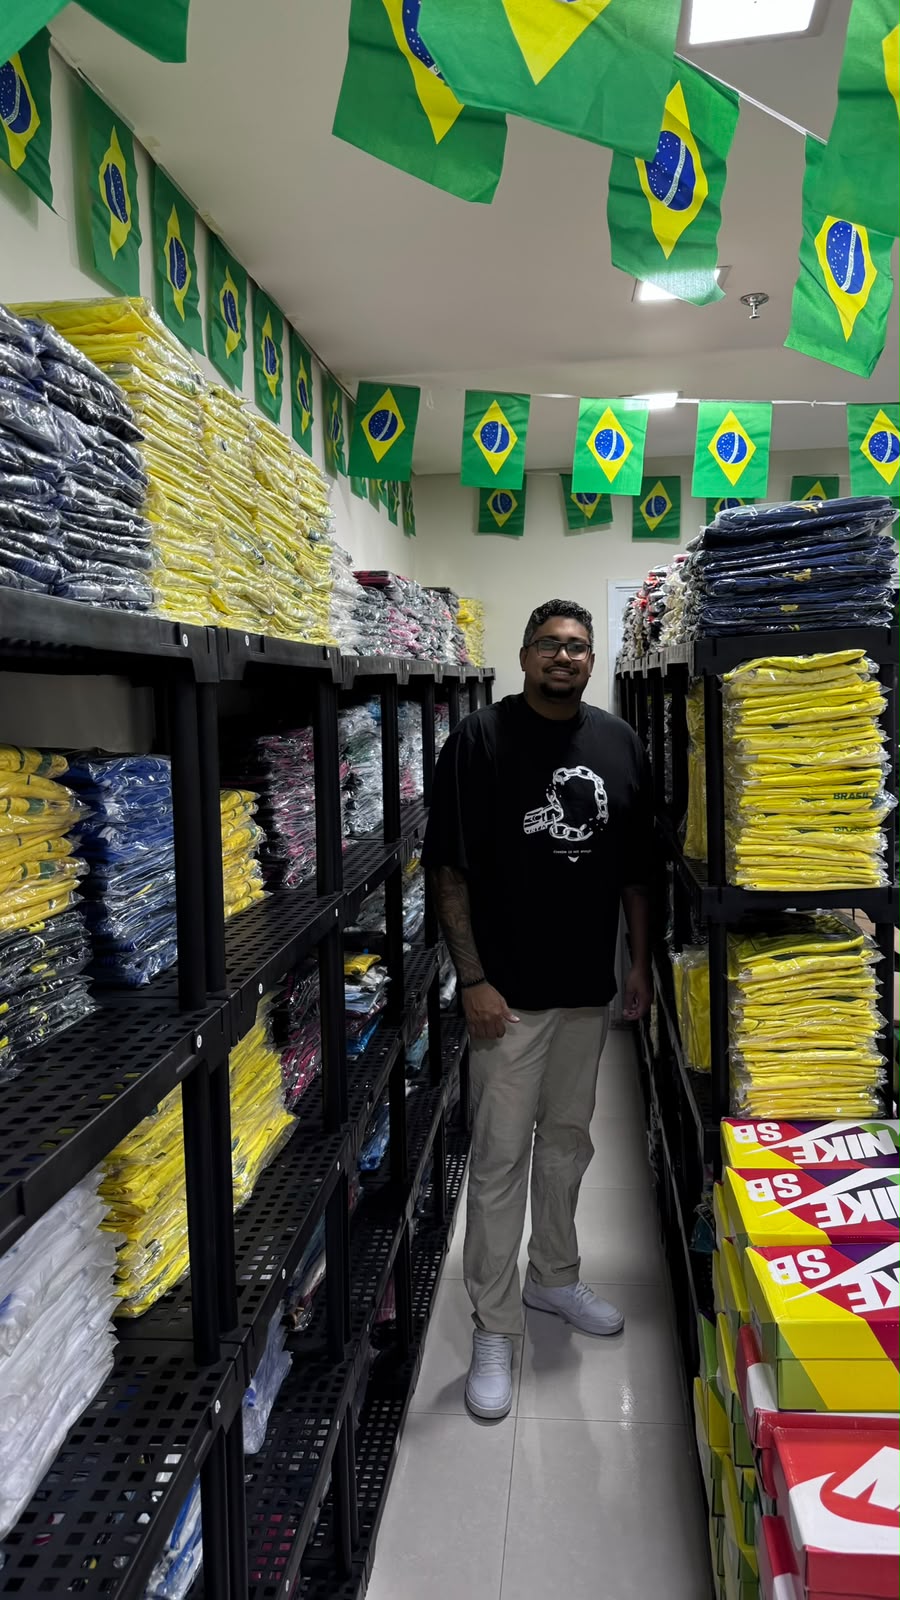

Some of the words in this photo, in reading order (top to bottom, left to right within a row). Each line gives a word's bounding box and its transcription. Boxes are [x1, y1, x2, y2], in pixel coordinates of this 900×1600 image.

[732, 1122, 783, 1144] SB
[789, 1129, 898, 1164] NIKE
[745, 1173, 802, 1203] SB
[767, 1248, 831, 1286] SB
